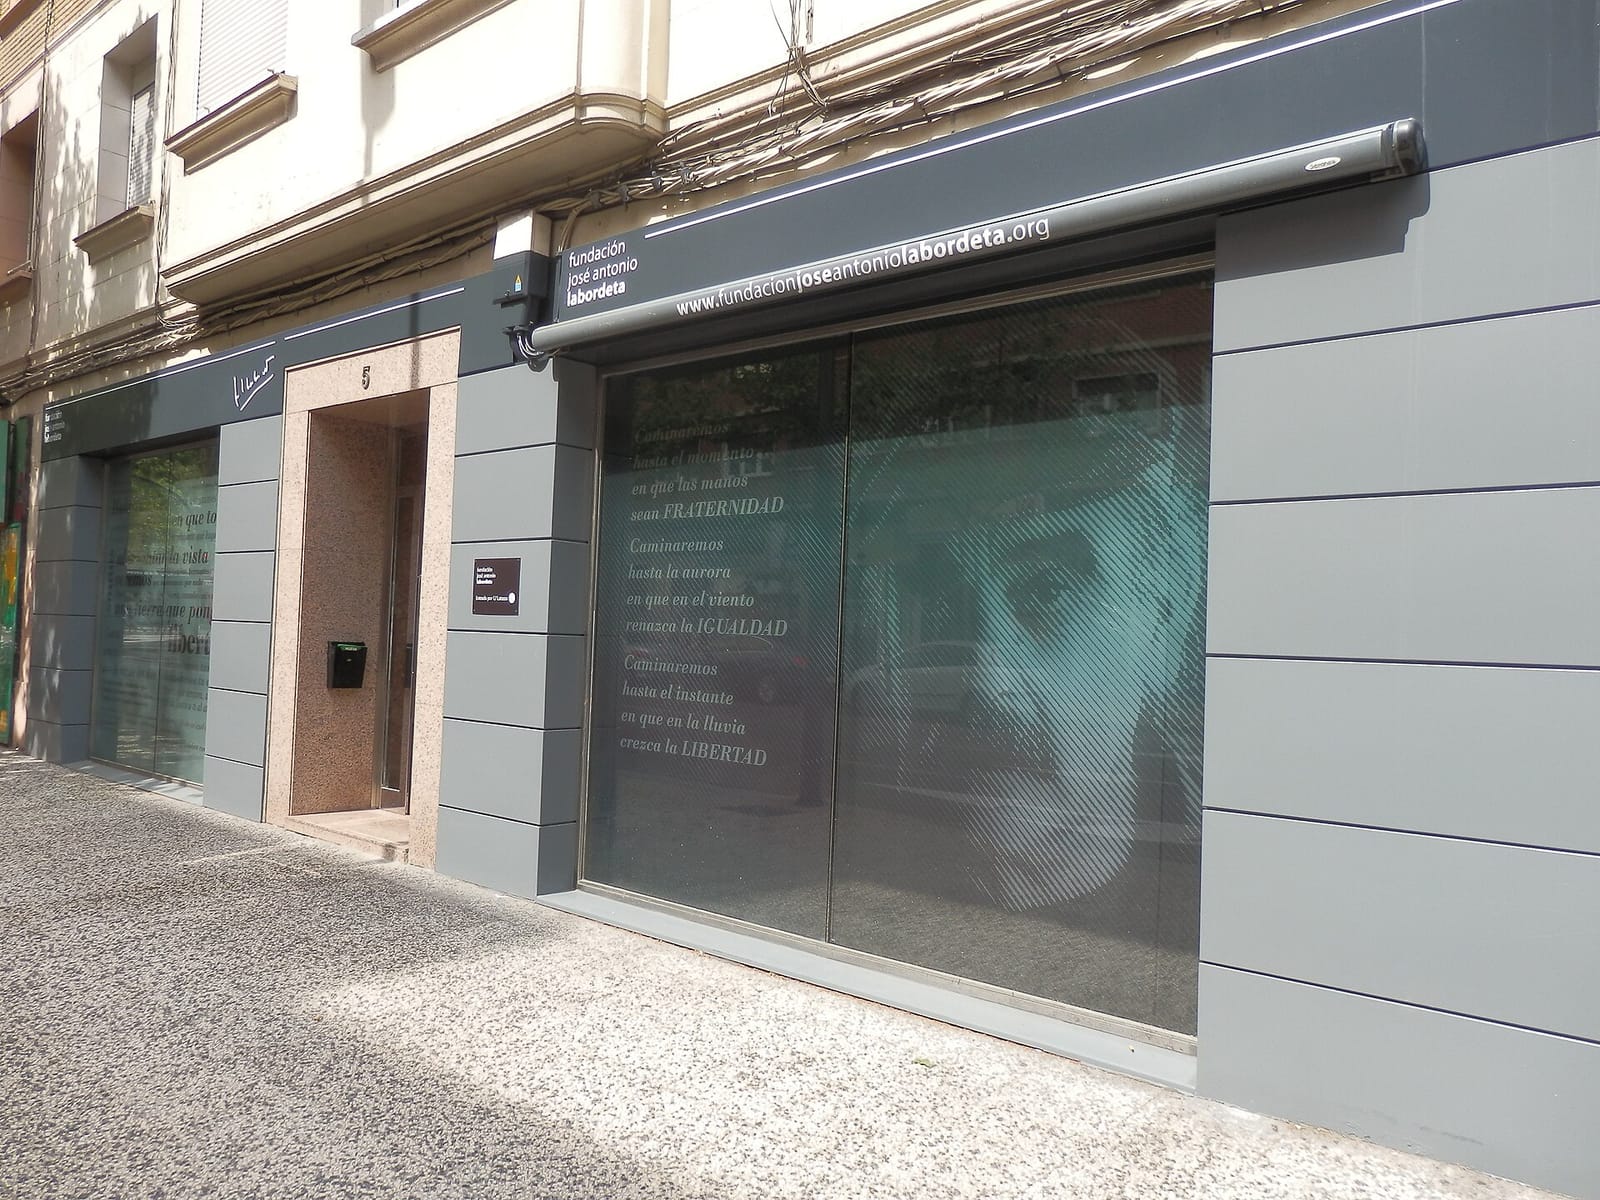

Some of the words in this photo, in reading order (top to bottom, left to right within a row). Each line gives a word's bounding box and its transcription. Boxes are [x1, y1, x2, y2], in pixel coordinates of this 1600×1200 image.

[568, 240, 626, 268] fundación
[676, 215, 1051, 317] www.fundacionjoseantoniolabordeta.org
[566, 267, 590, 292] josé
[592, 256, 639, 281] antonio
[566, 281, 626, 307] labordeta
[361, 365, 371, 390] 5
[632, 453, 668, 470] hasta
[671, 450, 684, 465] el
[631, 483, 647, 496] en
[650, 480, 674, 499] que
[678, 476, 698, 491] las
[700, 475, 749, 490] manos
[630, 508, 659, 521] sean
[663, 496, 785, 519] FRATERNIDAD
[186, 513, 203, 531] que
[182, 545, 209, 564] vista
[630, 536, 724, 553] Caminaremos
[628, 564, 662, 579] hasta
[666, 563, 679, 578] la
[682, 567, 732, 579] aurora
[626, 594, 641, 605] en
[645, 593, 669, 610] que
[672, 595, 688, 606] en
[692, 590, 705, 606] el
[709, 591, 754, 607] viento
[165, 604, 186, 623] que
[626, 620, 676, 633] renazca
[680, 618, 693, 633] la
[697, 617, 788, 637] IGUALDAD
[624, 654, 718, 676] Caminaremos
[622, 681, 657, 698] hasta
[660, 684, 673, 700] el
[676, 686, 735, 705] instante
[621, 711, 635, 723] en
[639, 713, 663, 729] que
[666, 716, 683, 728] en
[686, 713, 700, 730] la
[703, 714, 746, 735] lluvia
[620, 738, 661, 753] crezca
[665, 738, 678, 755] la
[681, 740, 768, 767] LIBERTAD
